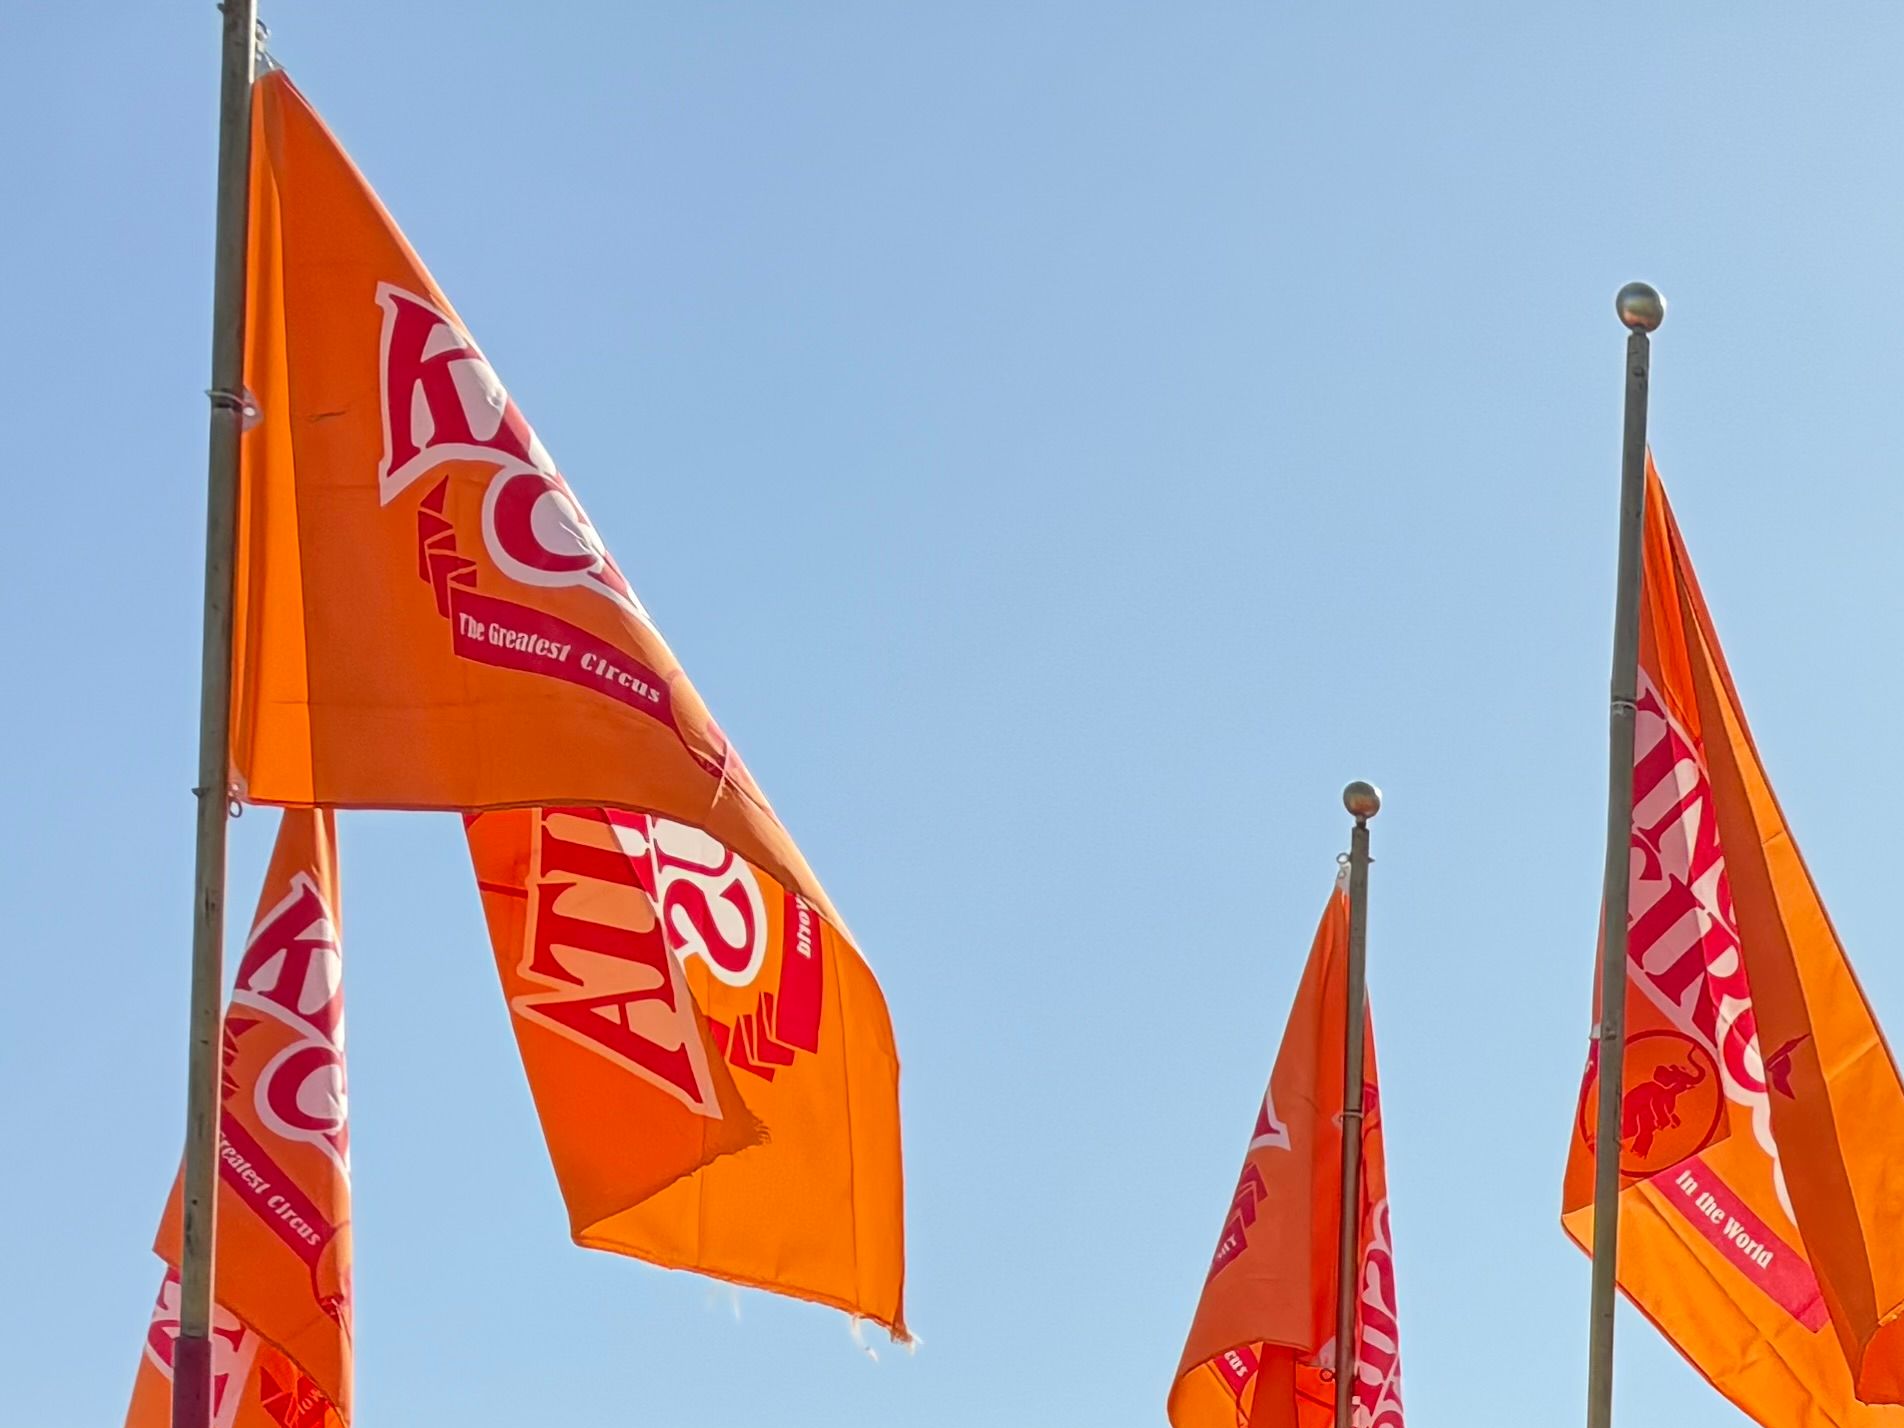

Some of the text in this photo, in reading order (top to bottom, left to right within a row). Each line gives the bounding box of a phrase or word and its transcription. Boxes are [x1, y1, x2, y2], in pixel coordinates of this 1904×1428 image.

[459, 613, 659, 703] The Greatest Circus
[219, 1127, 268, 1196] reatest
[267, 1194, 322, 1248] Circus
[1691, 1189, 1724, 1226] the
[1721, 1215, 1773, 1269] World
